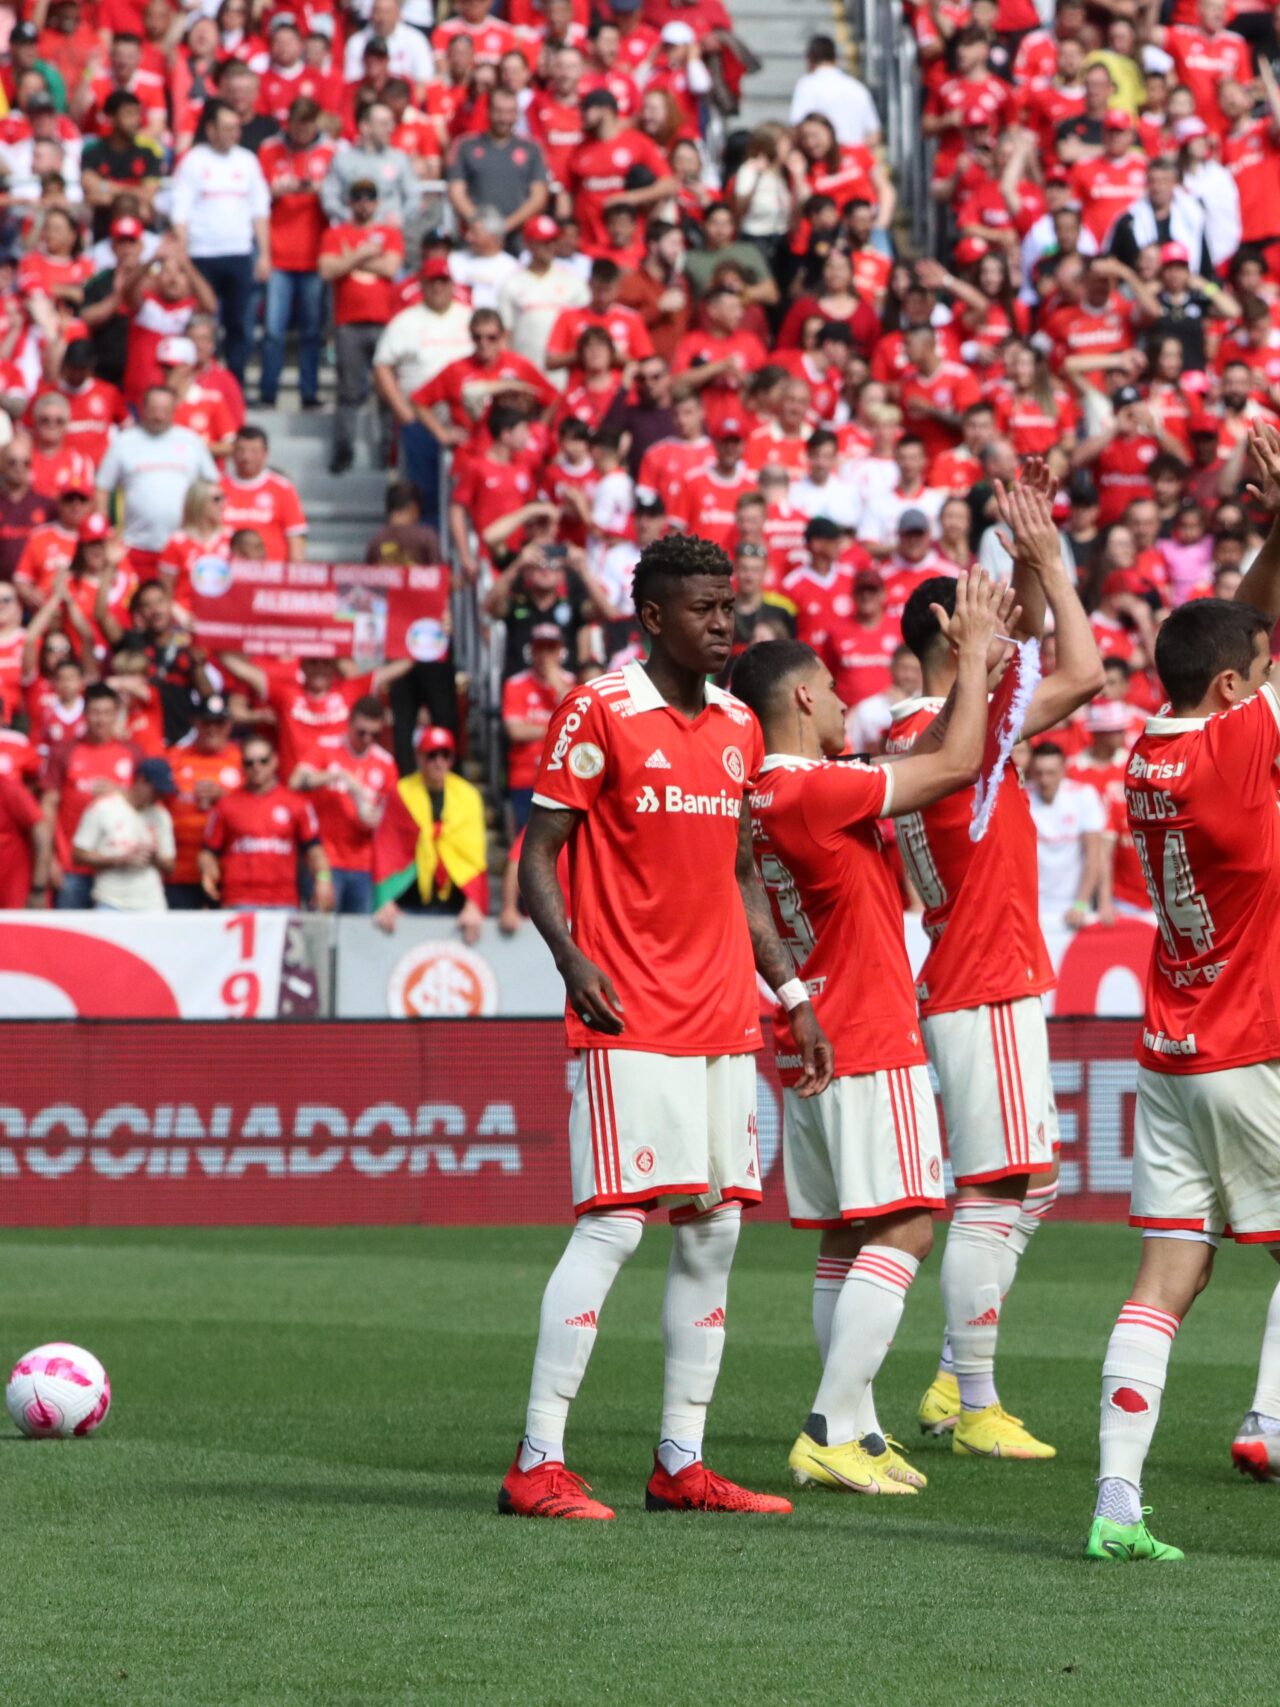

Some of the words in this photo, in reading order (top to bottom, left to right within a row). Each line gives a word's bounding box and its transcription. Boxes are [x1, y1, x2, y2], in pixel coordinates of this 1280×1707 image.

[546, 712, 582, 771] vero
[665, 784, 741, 819] Banrisu
[1132, 829, 1216, 962] 14
[1143, 1027, 1197, 1056] nimed
